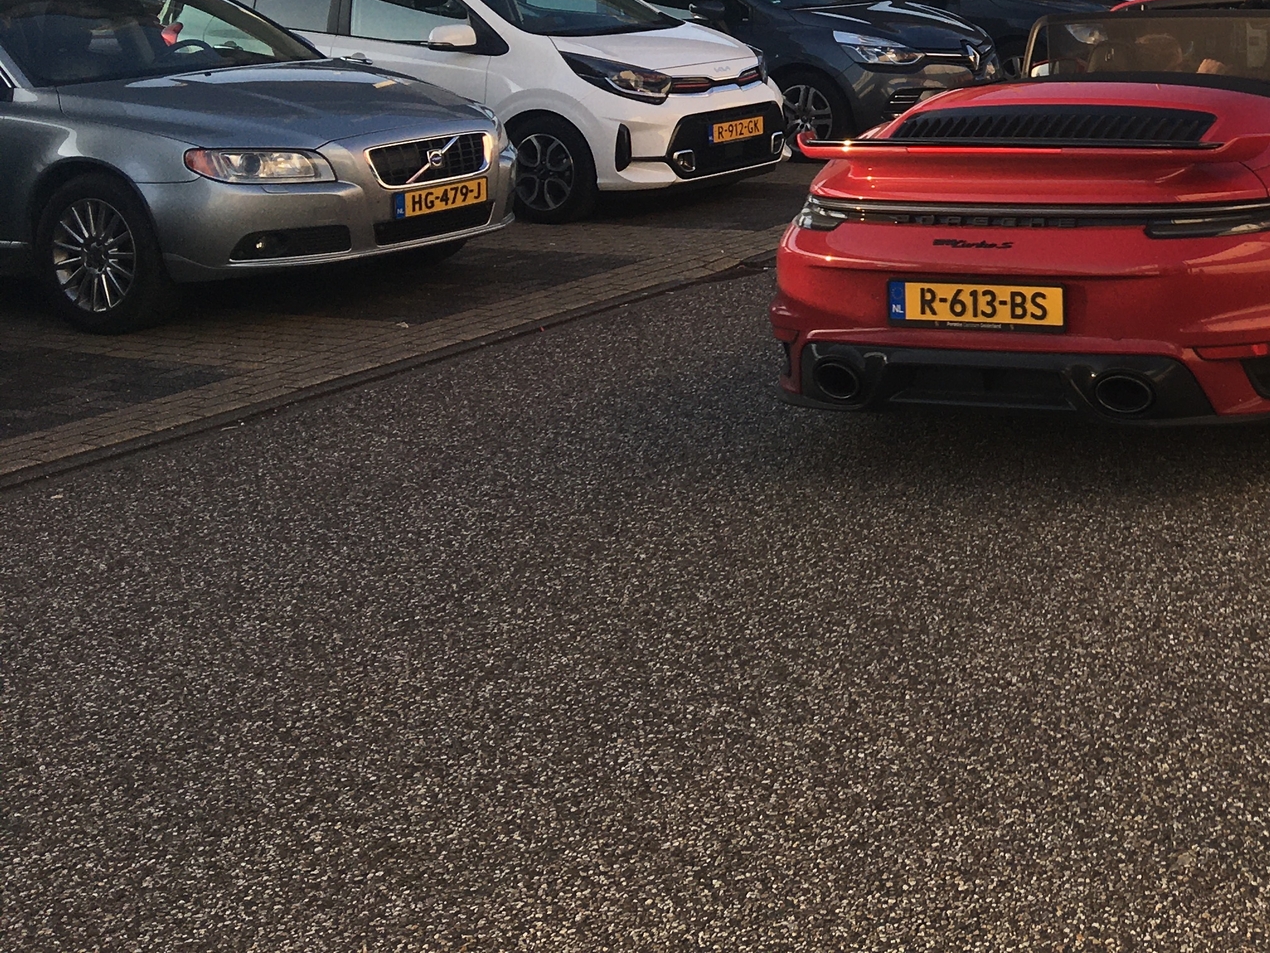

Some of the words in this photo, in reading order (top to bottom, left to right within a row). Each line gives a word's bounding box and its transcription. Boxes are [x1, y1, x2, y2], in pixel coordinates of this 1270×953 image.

[717, 119, 760, 140] R-912-GK
[411, 181, 482, 213] HG-479-J
[892, 304, 904, 313] NL
[919, 287, 1048, 321] R-613-BS
